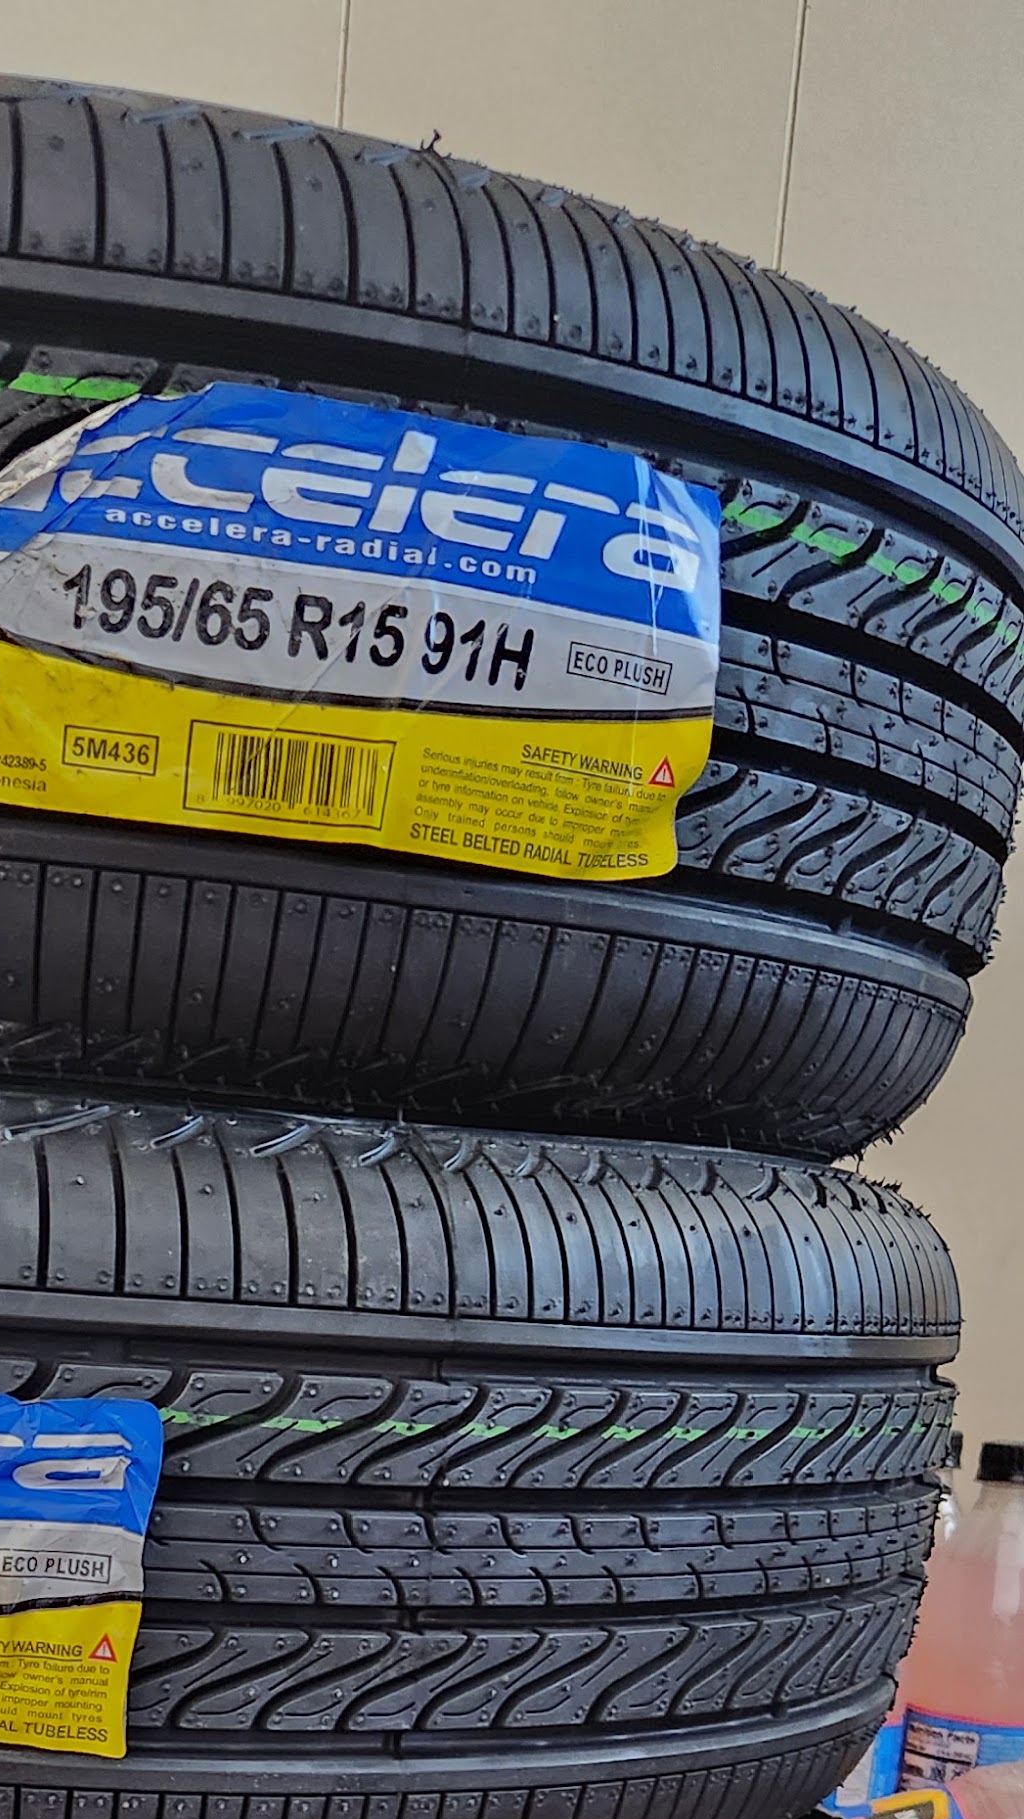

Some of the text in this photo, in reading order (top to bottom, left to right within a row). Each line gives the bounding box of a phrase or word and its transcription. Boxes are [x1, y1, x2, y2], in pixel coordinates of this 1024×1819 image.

[105, 506, 536, 584] accelera-radial.com
[63, 564, 535, 691] 195/65 R15 91H
[573, 651, 666, 690] ECO PLUSH
[72, 736, 150, 766] 5M436
[521, 743, 643, 780] SAFETY WARNING
[422, 747, 461, 765] Serious
[463, 757, 499, 772] injuries
[501, 763, 523, 778] may
[582, 777, 601, 792] Tyre
[636, 789, 656, 800] due
[432, 780, 451, 795] tyre
[453, 784, 508, 801] information
[564, 804, 609, 821] Explosion
[468, 801, 490, 815] may
[495, 807, 523, 818] occur
[528, 812, 546, 824] due
[414, 806, 439, 821] Only
[448, 811, 485, 828] trained
[493, 821, 537, 838] persons
[410, 823, 649, 868] STEEL BELTED RADIAL TUBELESS
[2, 1555, 104, 1577] ECO PLUSH
[13, 1640, 83, 1657] WARNING
[18, 1659, 39, 1670] Tyre
[43, 1660, 74, 1673] failure
[77, 1661, 96, 1674] due
[99, 1666, 110, 1675] to
[23, 1671, 64, 1684] owner's
[70, 1677, 109, 1686] manual
[0, 1681, 50, 1695] Explosion
[54, 1687, 66, 1697] of
[68, 1687, 107, 1699] tyre/rim
[1, 1692, 48, 1708] improper
[54, 1700, 102, 1712] mounting
[27, 1710, 63, 1720] mount
[24, 1721, 108, 1742] TUBELESS
